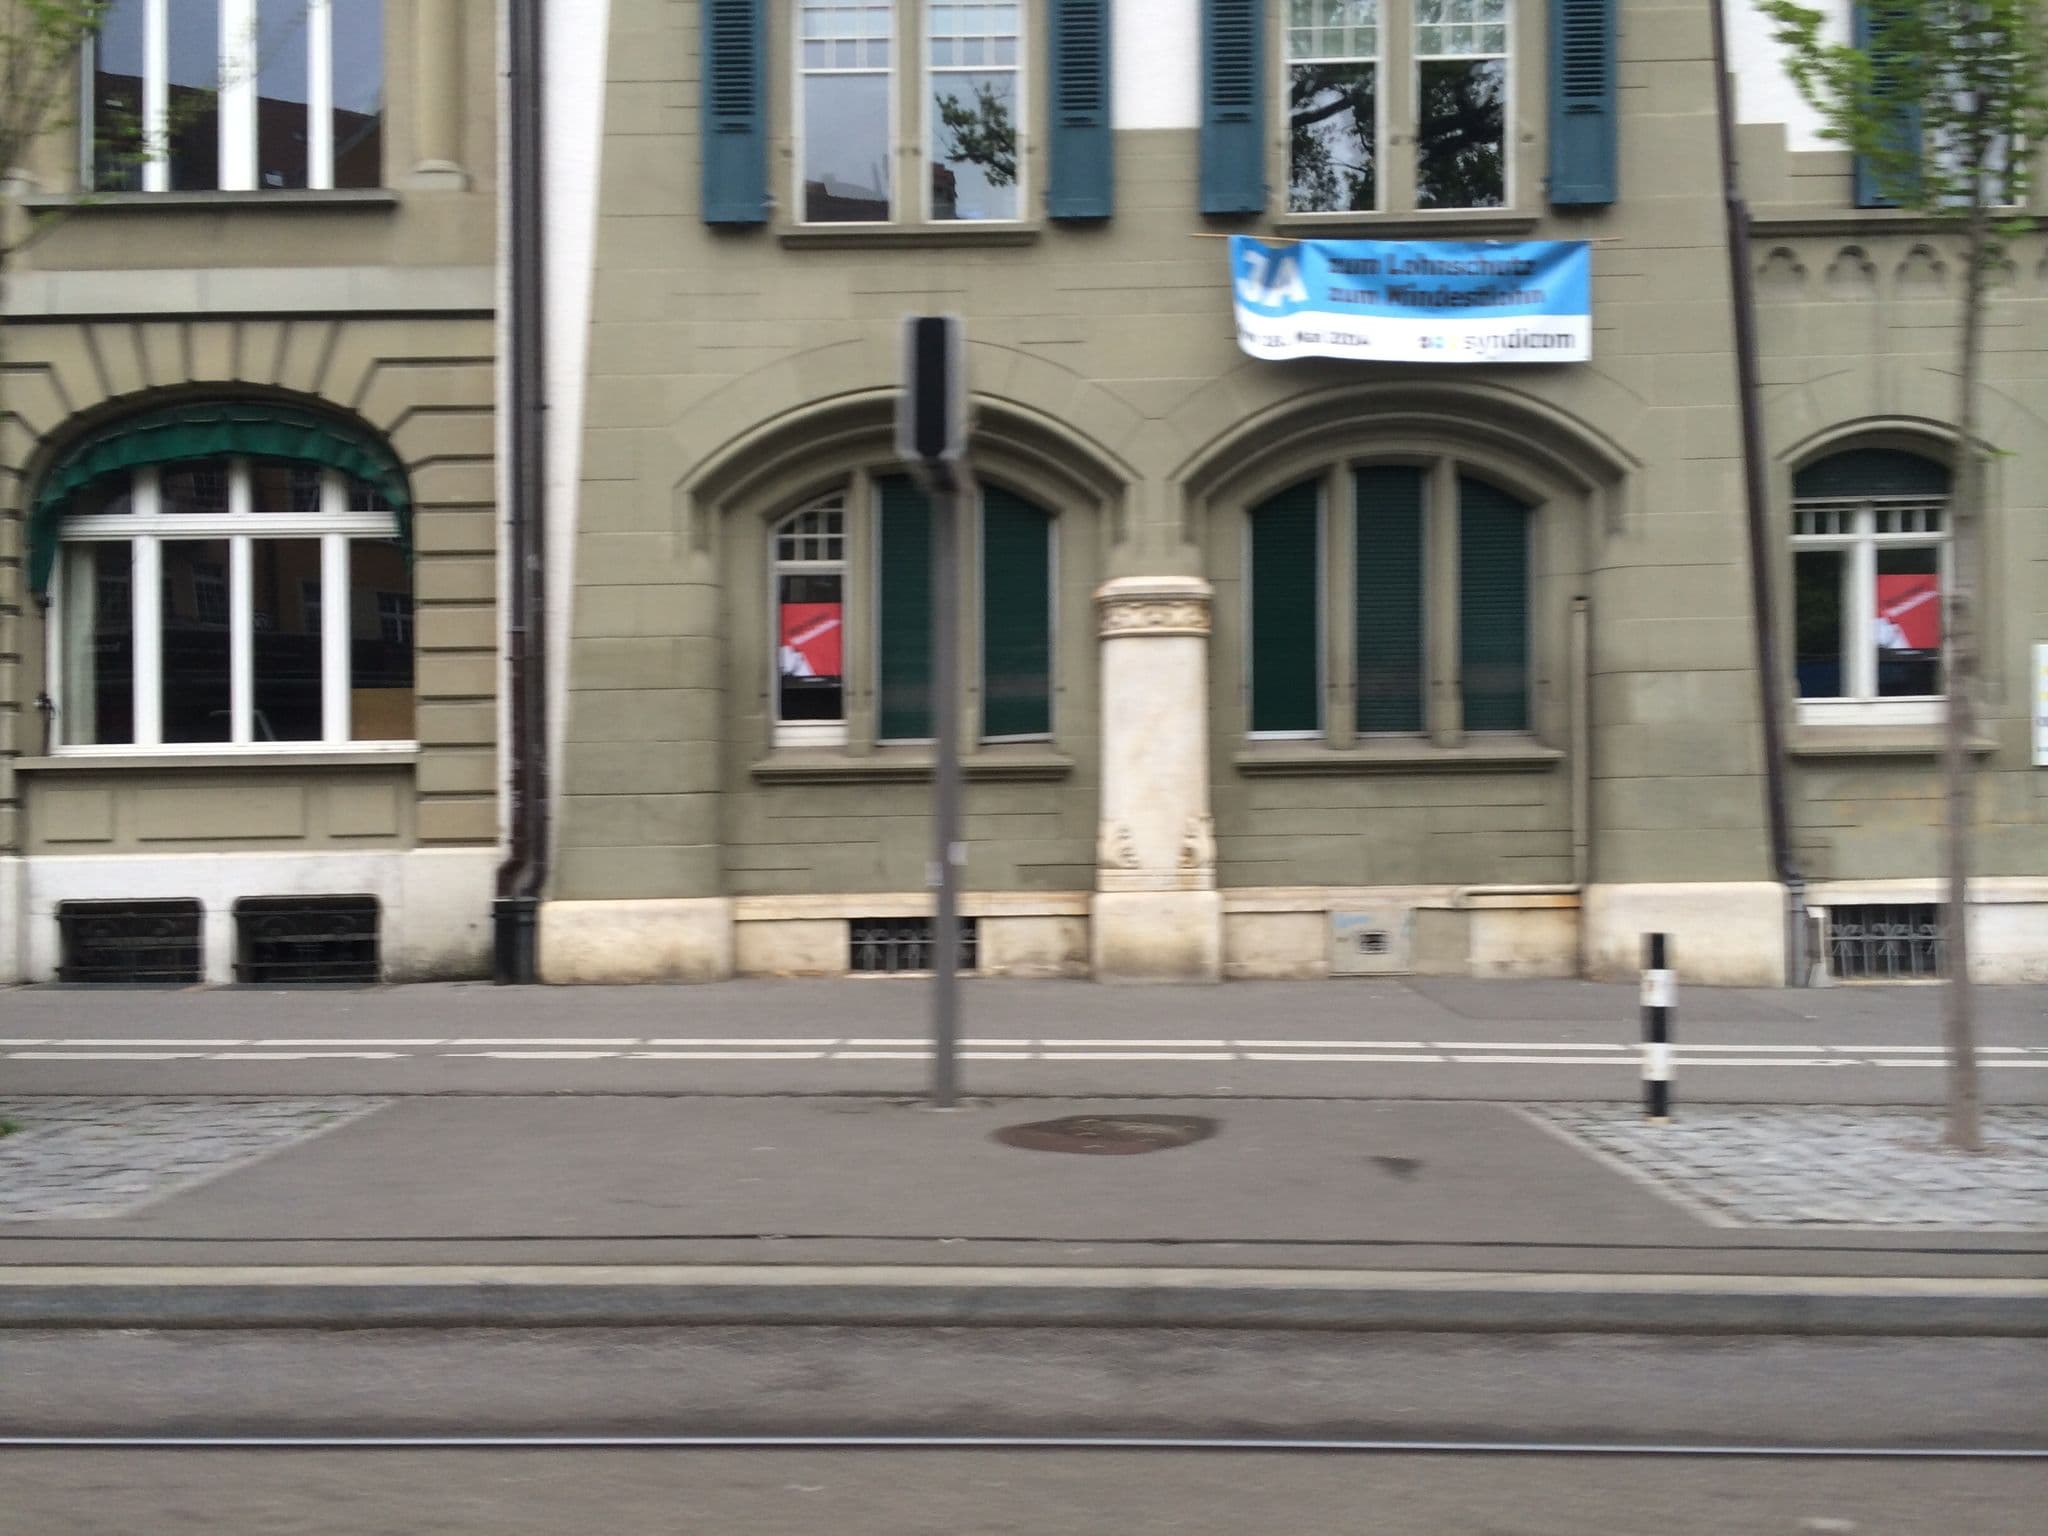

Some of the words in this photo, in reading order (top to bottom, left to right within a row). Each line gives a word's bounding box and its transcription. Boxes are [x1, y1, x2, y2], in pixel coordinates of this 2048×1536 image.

[1328, 257, 1379, 275] zum
[1240, 250, 1309, 307] JA
[1328, 288, 1379, 304] zum
[1386, 285, 1545, 306] Mindestlohn
[1463, 328, 1576, 354] syndicom
